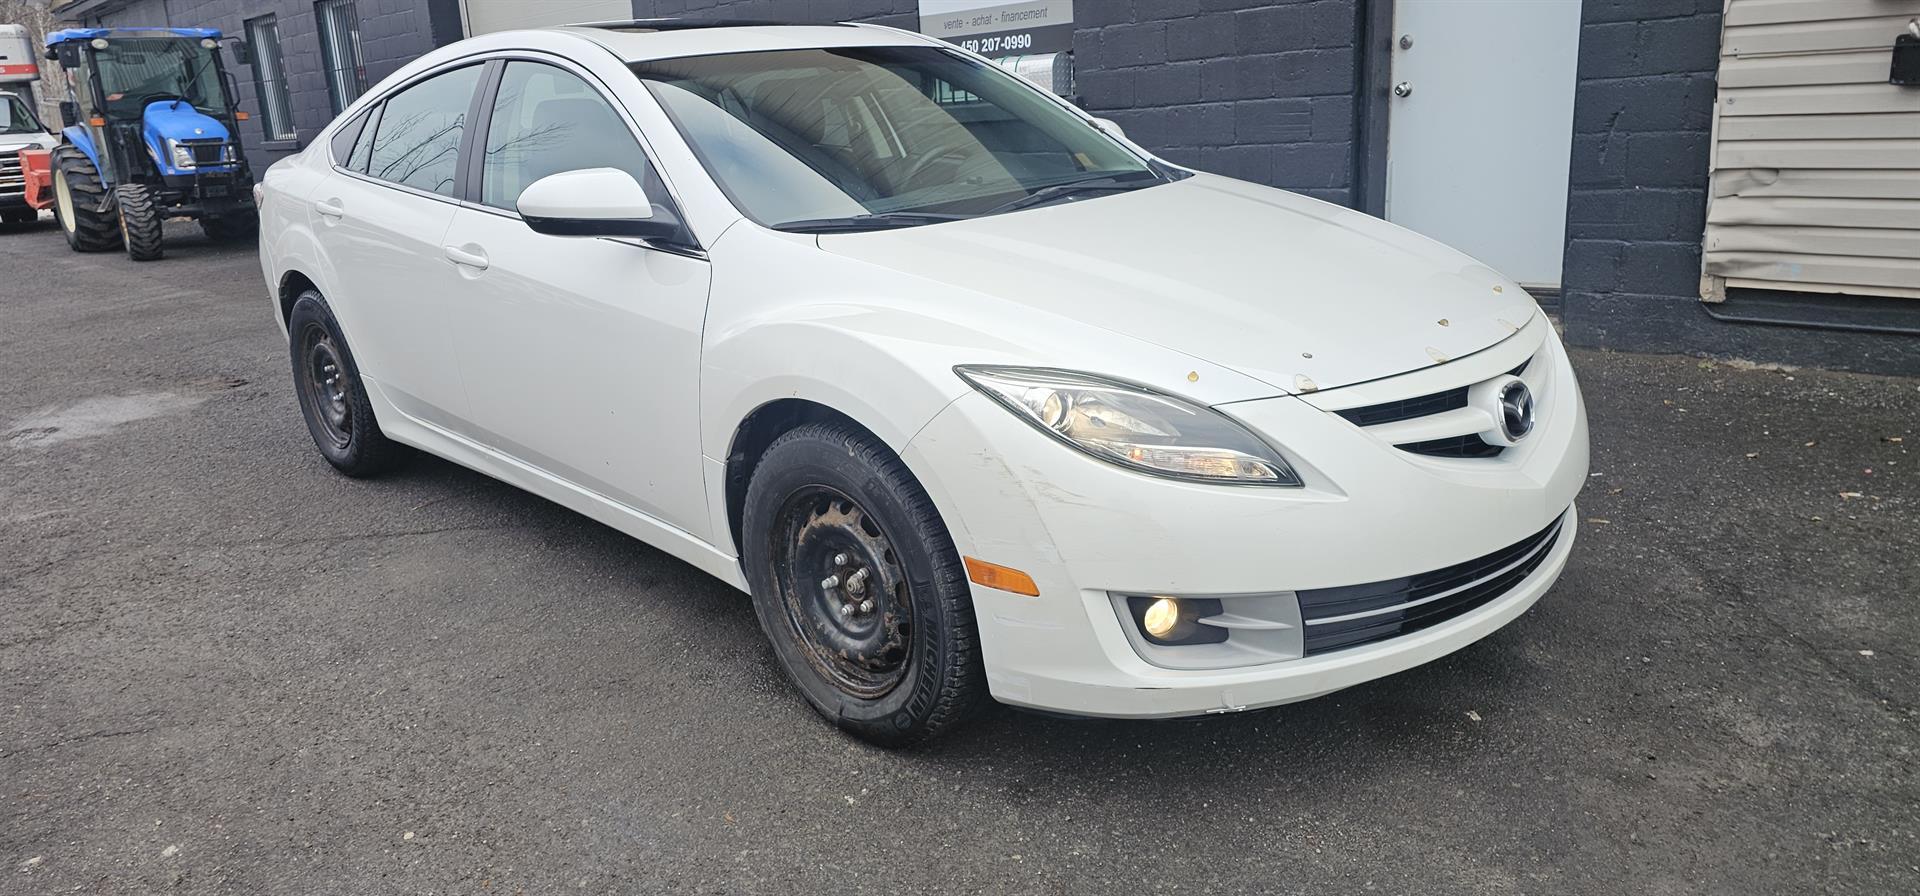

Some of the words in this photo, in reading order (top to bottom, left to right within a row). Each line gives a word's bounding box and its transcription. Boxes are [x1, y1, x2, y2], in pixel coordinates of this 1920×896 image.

[943, 18, 964, 30] vente
[972, 14, 992, 26] achat
[1001, 8, 1048, 22] financement
[961, 39, 979, 53] 450
[981, 34, 1032, 52] 207-0990
[908, 618, 938, 719] MICHELIN
